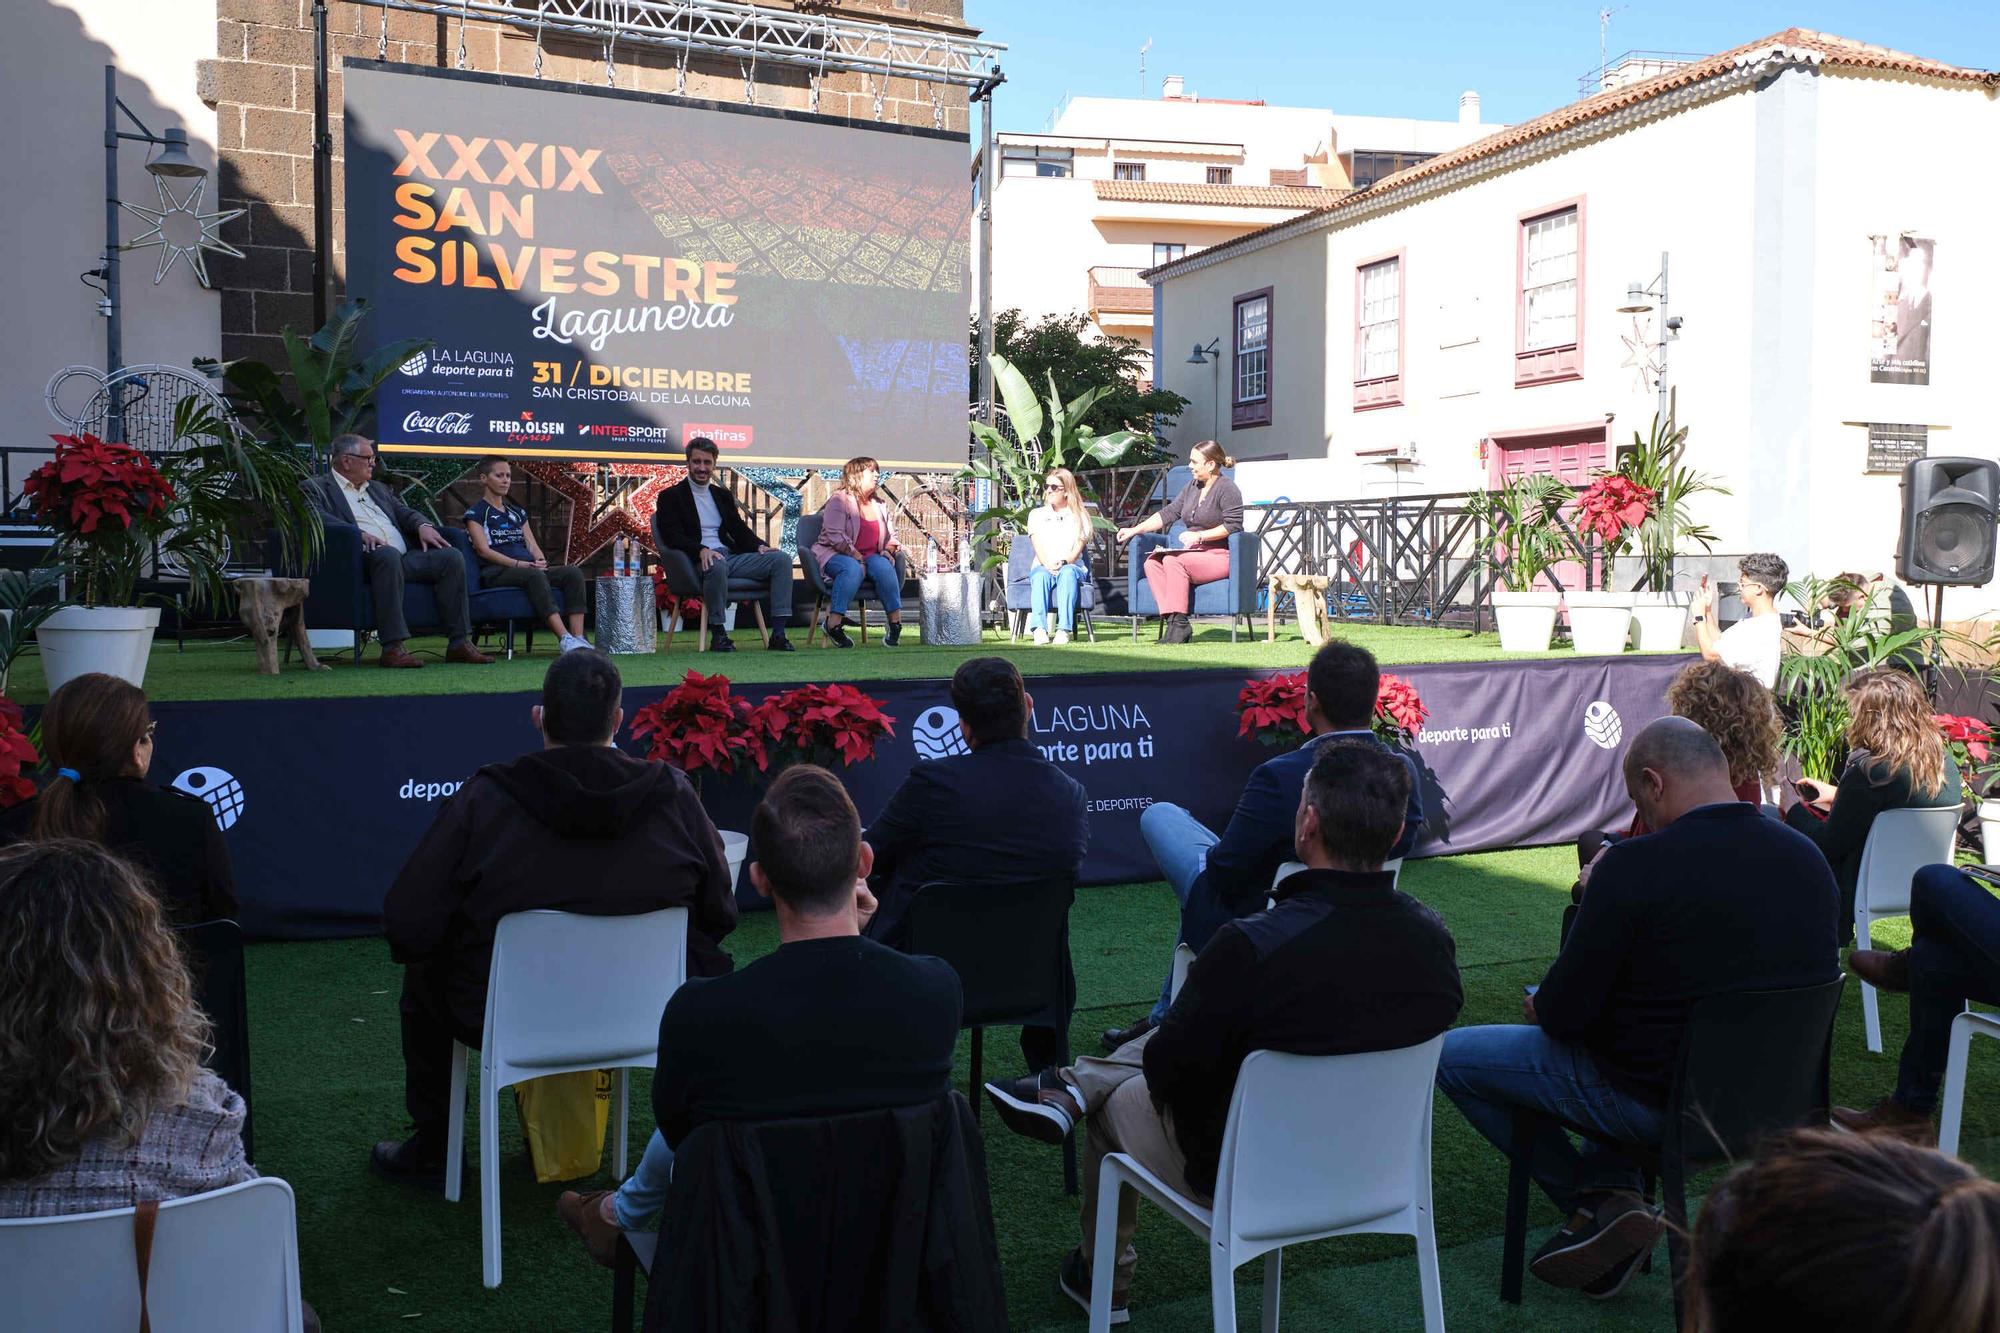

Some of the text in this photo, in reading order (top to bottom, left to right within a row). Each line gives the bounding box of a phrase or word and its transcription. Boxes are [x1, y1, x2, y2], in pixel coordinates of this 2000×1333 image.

[392, 128, 604, 195] XXXIX
[392, 182, 534, 240] SAN
[392, 235, 739, 306] SILVESTRE
[531, 296, 735, 351] Lagunera
[432, 349, 514, 364] LA LAGUNA
[432, 363, 514, 378] deporte para ti
[532, 360, 752, 393] 31 / DICIEMBRE
[479, 391, 509, 399] DEPORTES
[532, 386, 752, 408] SAN CRISTOBAL DE LA LAGUNA
[403, 410, 474, 435] Coca-Cola
[591, 425, 668, 439] INTERSPORT
[689, 427, 747, 442] chafiras
[1031, 704, 1151, 733] LAGUNA
[1418, 722, 1511, 746] deporte para ti
[1084, 741, 1133, 765] para
[1137, 734, 1154, 757] ti
[399, 778, 465, 802] depor
[1096, 797, 1153, 812] DEPORTES
